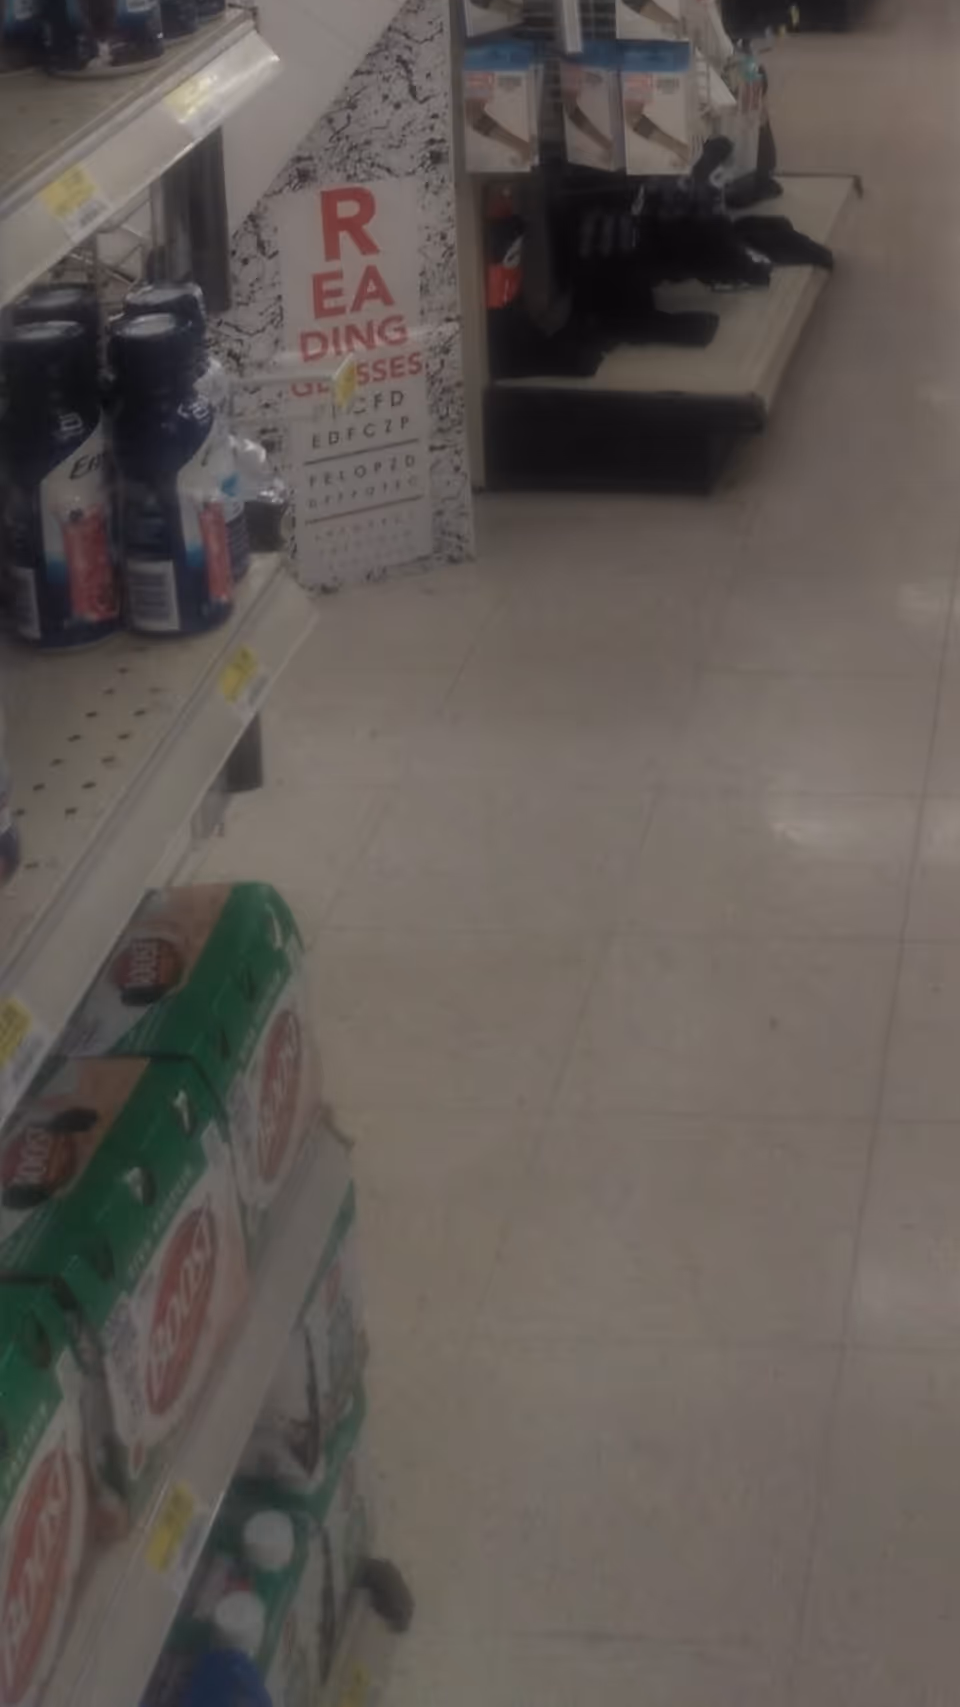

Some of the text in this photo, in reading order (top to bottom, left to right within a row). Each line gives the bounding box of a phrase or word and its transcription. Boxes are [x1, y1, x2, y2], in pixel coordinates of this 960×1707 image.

[320, 186, 380, 262] R
[311, 264, 396, 320] EA
[300, 314, 408, 362] DING
